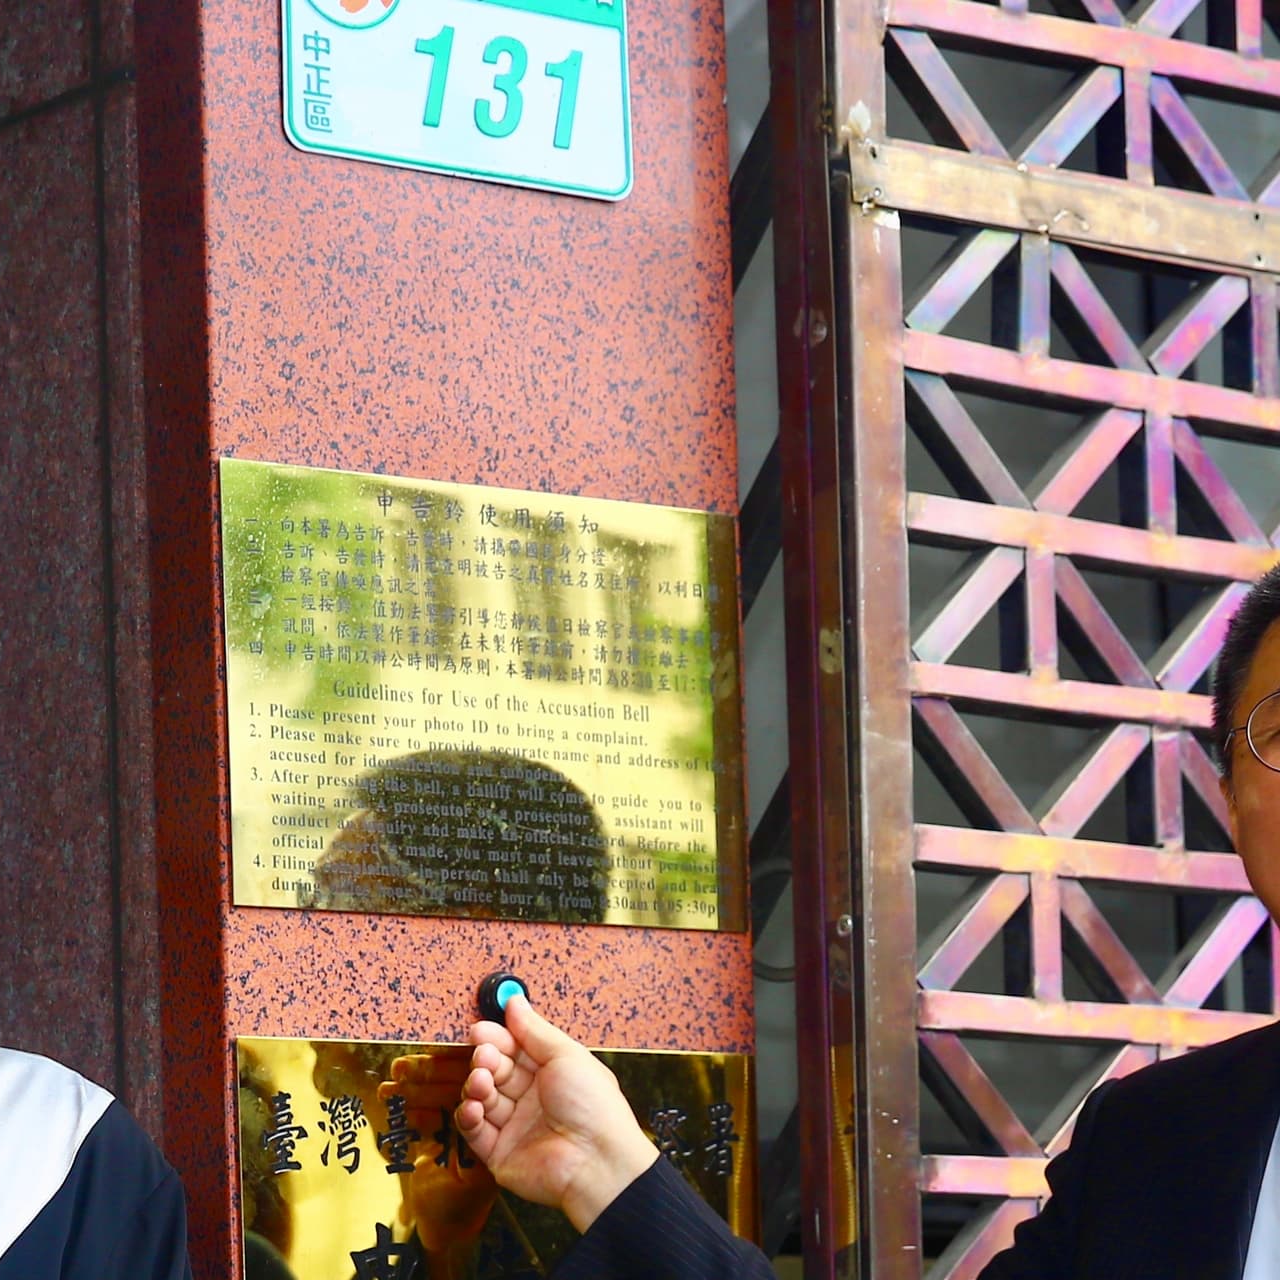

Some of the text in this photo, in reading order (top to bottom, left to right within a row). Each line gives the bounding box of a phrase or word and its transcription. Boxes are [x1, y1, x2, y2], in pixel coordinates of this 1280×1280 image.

[303, 30, 333, 133] 中正區
[414, 24, 583, 150] 131
[375, 493, 600, 536] 申告鈴使用須知
[333, 681, 649, 721] Guidelines for Use of the Accusation Bell
[248, 701, 648, 748] 1. Please present your photo ID to bring a complaint.
[248, 724, 261, 739] 2.
[270, 725, 315, 742] Please
[323, 729, 361, 746] make
[368, 735, 400, 748] sure
[407, 735, 420, 750] to
[427, 737, 482, 758] provide
[488, 741, 549, 759] accurate
[552, 748, 589, 761] name
[595, 749, 620, 764] and
[627, 751, 683, 768] address
[685, 755, 699, 769] of
[269, 747, 326, 764] accused
[335, 752, 355, 766] for
[467, 761, 494, 775] and
[250, 767, 262, 781] 3.
[270, 769, 308, 784] After
[316, 772, 377, 792] pressing
[384, 776, 406, 790] the
[414, 778, 444, 793] bell,
[452, 783, 459, 794] a
[517, 785, 543, 799] will
[550, 790, 583, 802] come
[591, 790, 605, 803] to
[610, 791, 648, 810] guide
[658, 794, 682, 812] you
[689, 796, 702, 809] to
[270, 792, 325, 812] waiting
[376, 799, 387, 812] A
[393, 800, 471, 821] prosecutor
[614, 814, 672, 829] assistant
[679, 818, 703, 831] will
[271, 814, 328, 829] conduct
[336, 820, 352, 830] an
[423, 823, 448, 836] and
[456, 825, 494, 838] make
[524, 829, 573, 843] official
[637, 835, 679, 849] Before
[687, 838, 706, 850] the
[272, 834, 323, 849] official
[405, 841, 448, 856] made,
[455, 844, 480, 862] you
[487, 846, 521, 860] must
[529, 848, 549, 862] not
[557, 850, 592, 864] leave
[252, 853, 265, 868] 4.
[271, 854, 315, 874] Filing
[419, 862, 433, 876] in
[440, 864, 488, 883] person
[494, 866, 528, 881] shall
[535, 869, 563, 887] only
[572, 871, 587, 884] be
[271, 876, 321, 898] during
[452, 885, 492, 902] office
[499, 888, 532, 904] hour
[558, 891, 590, 907] from
